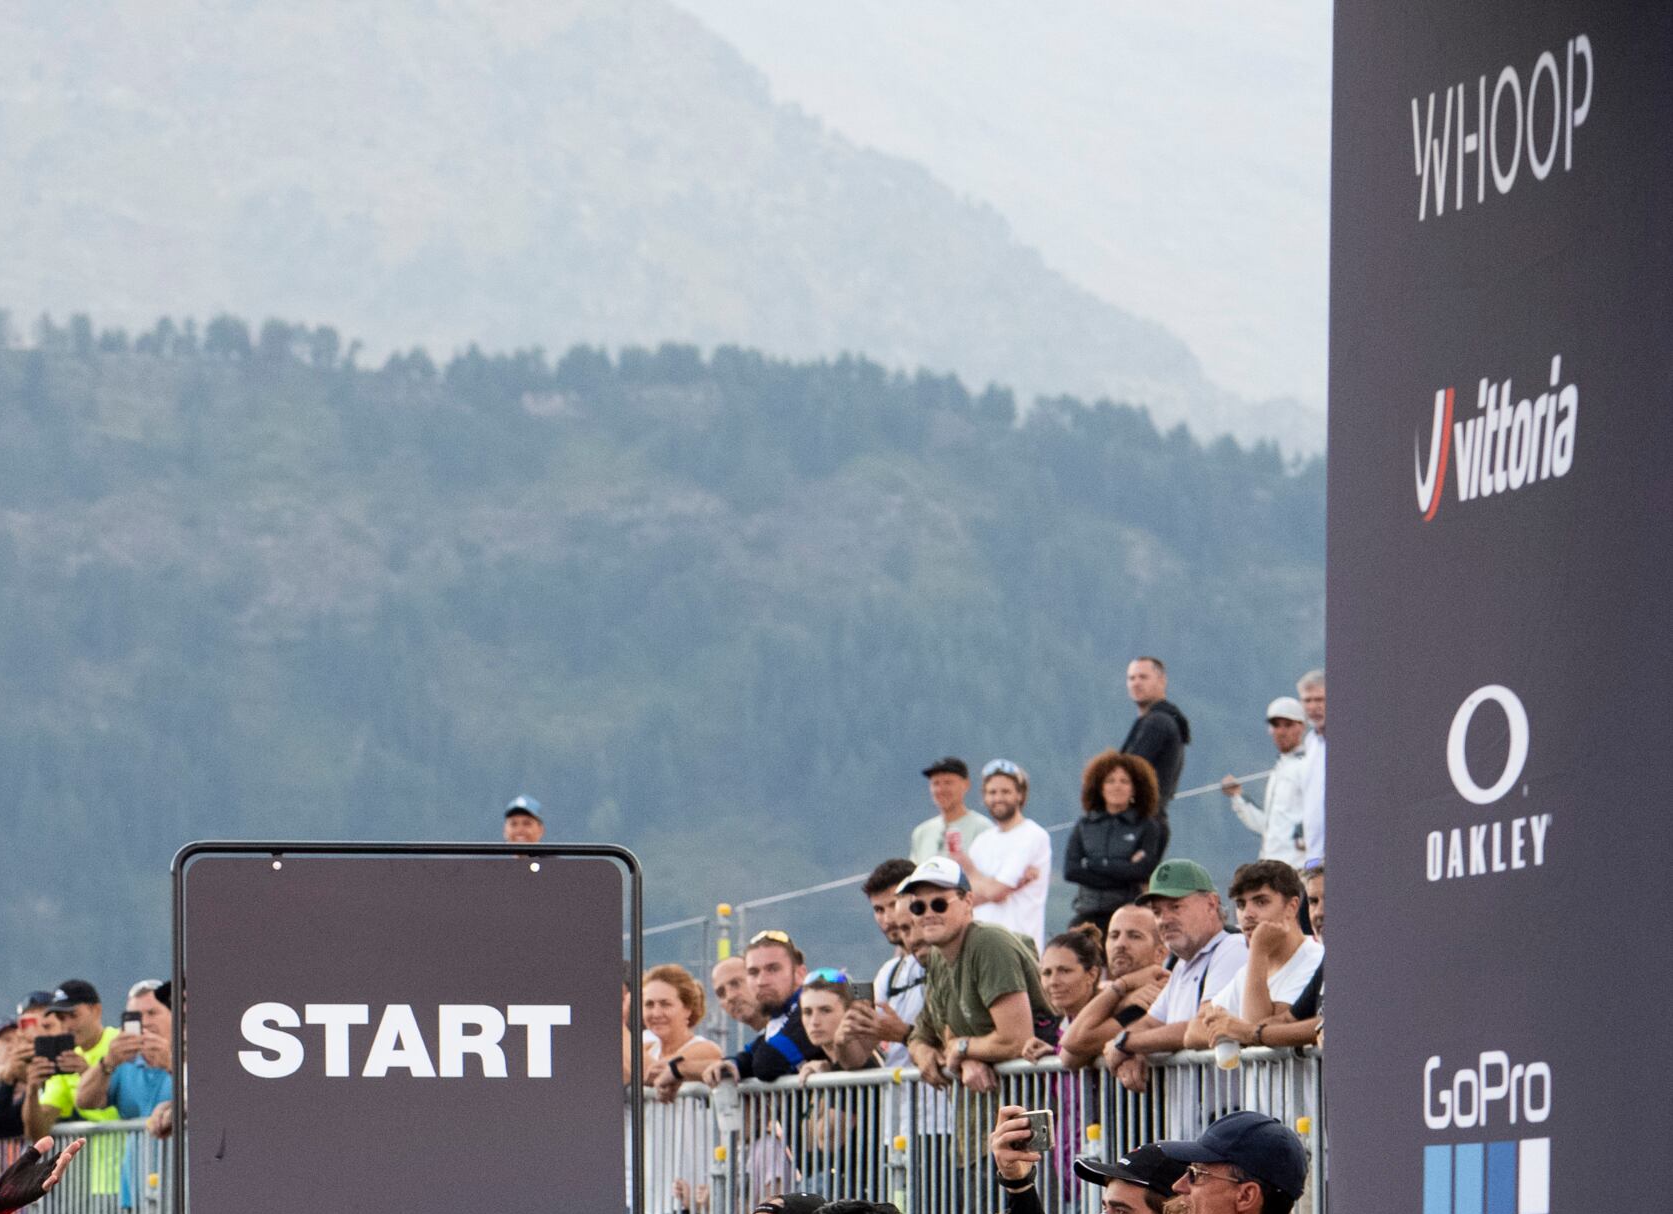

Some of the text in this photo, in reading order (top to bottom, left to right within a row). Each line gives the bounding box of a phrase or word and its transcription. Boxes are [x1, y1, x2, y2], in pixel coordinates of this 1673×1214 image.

[1411, 34, 1594, 222] WHOOP
[1454, 354, 1578, 502] vittoria
[1426, 813, 1551, 882] OAKLEY
[237, 1001, 572, 1079] START
[1423, 1049, 1552, 1130] GoPro
